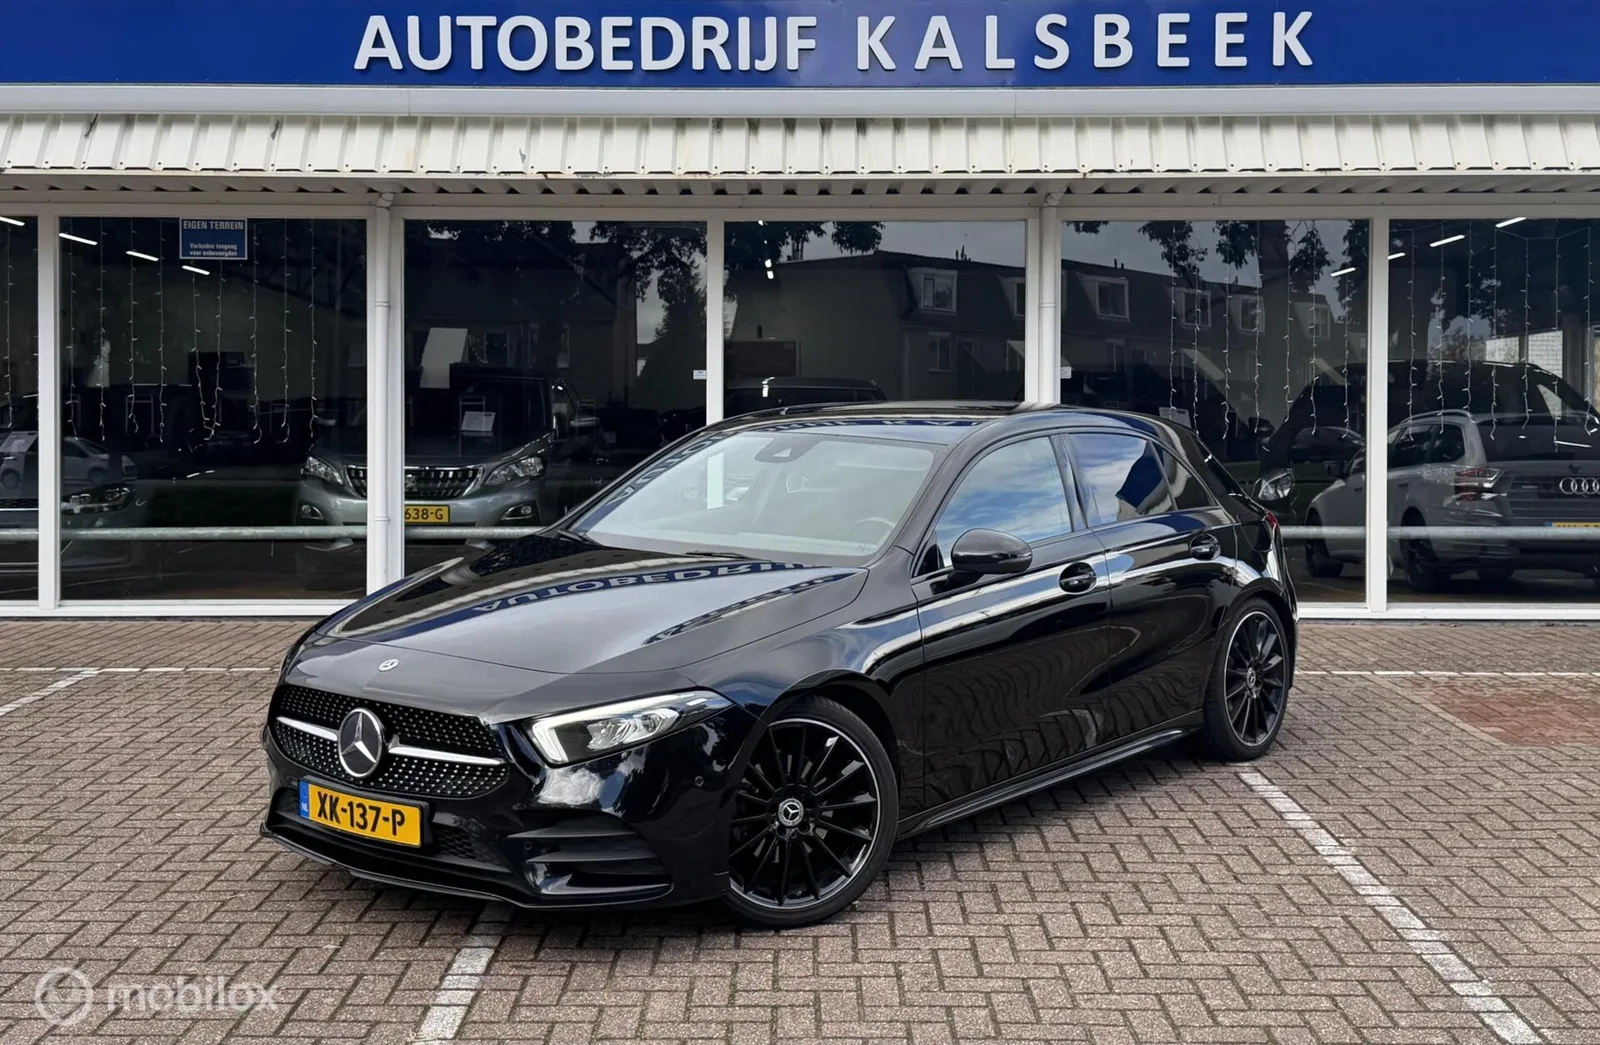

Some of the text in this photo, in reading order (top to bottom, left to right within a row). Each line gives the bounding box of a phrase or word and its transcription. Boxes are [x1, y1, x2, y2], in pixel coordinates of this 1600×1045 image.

[354, 11, 1313, 72] AUTOBEDRIJF KALSBEEK
[183, 220, 244, 230] EIGEN TERREIN
[317, 791, 406, 836] XK-137-P
